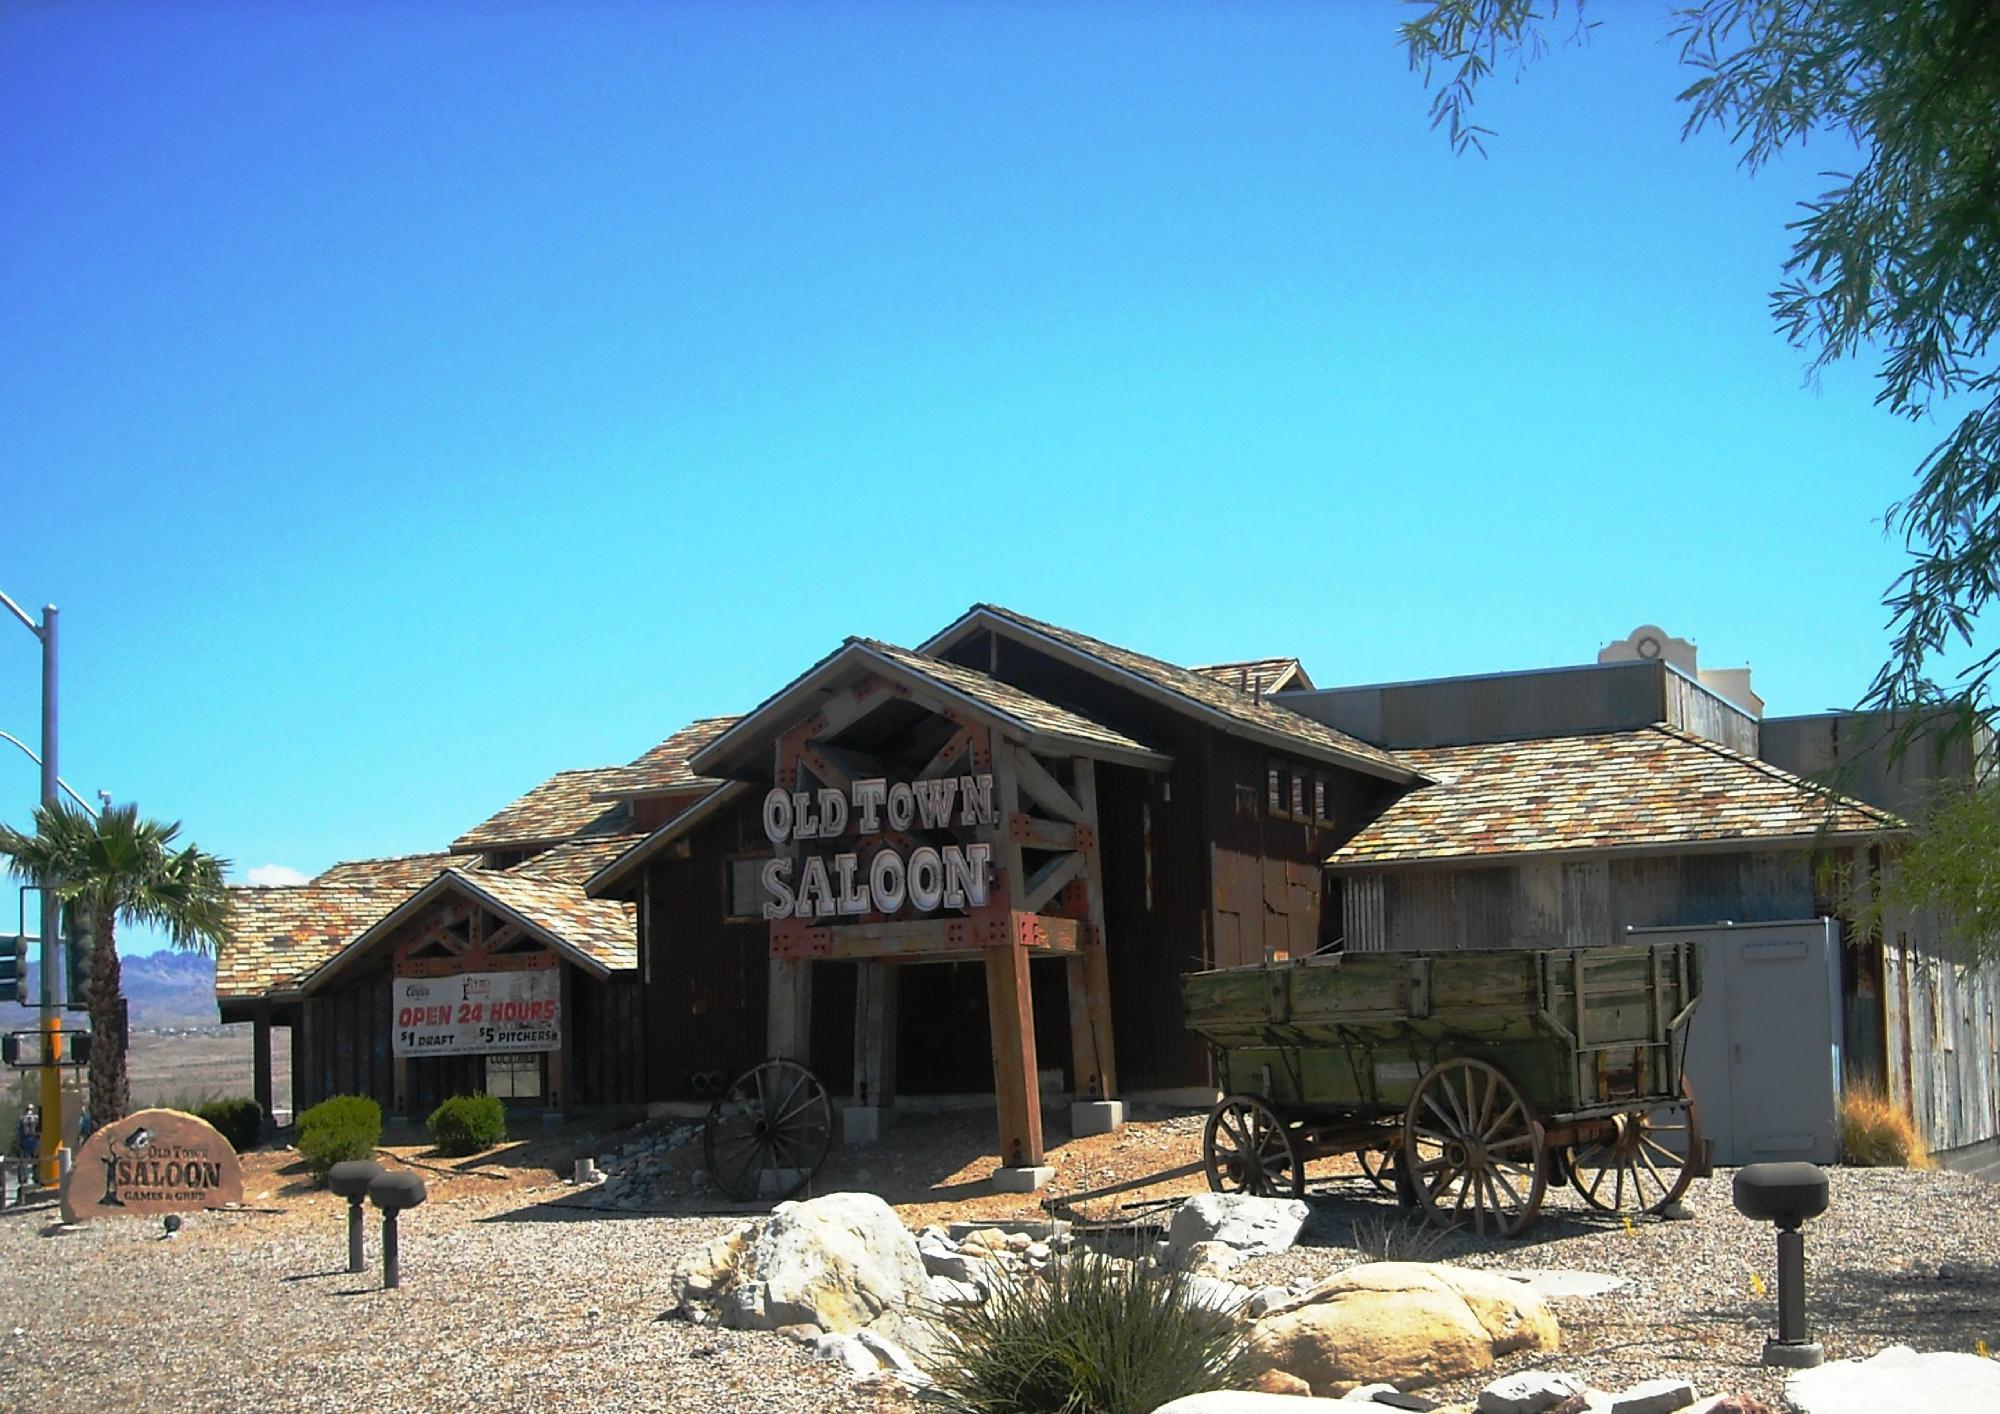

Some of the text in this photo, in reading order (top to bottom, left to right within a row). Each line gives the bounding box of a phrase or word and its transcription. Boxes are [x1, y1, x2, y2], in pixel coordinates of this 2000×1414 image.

[763, 774, 993, 843] OLD TOWN
[761, 843, 991, 920] SALOON
[399, 1000, 556, 1028] OPEN 24 HOURS
[401, 1031, 454, 1046] $1 DRAFT
[479, 1027, 551, 1043] $5 PITCHERS
[117, 1161, 222, 1188] SALOON
[124, 1192, 163, 1201] GAMES
